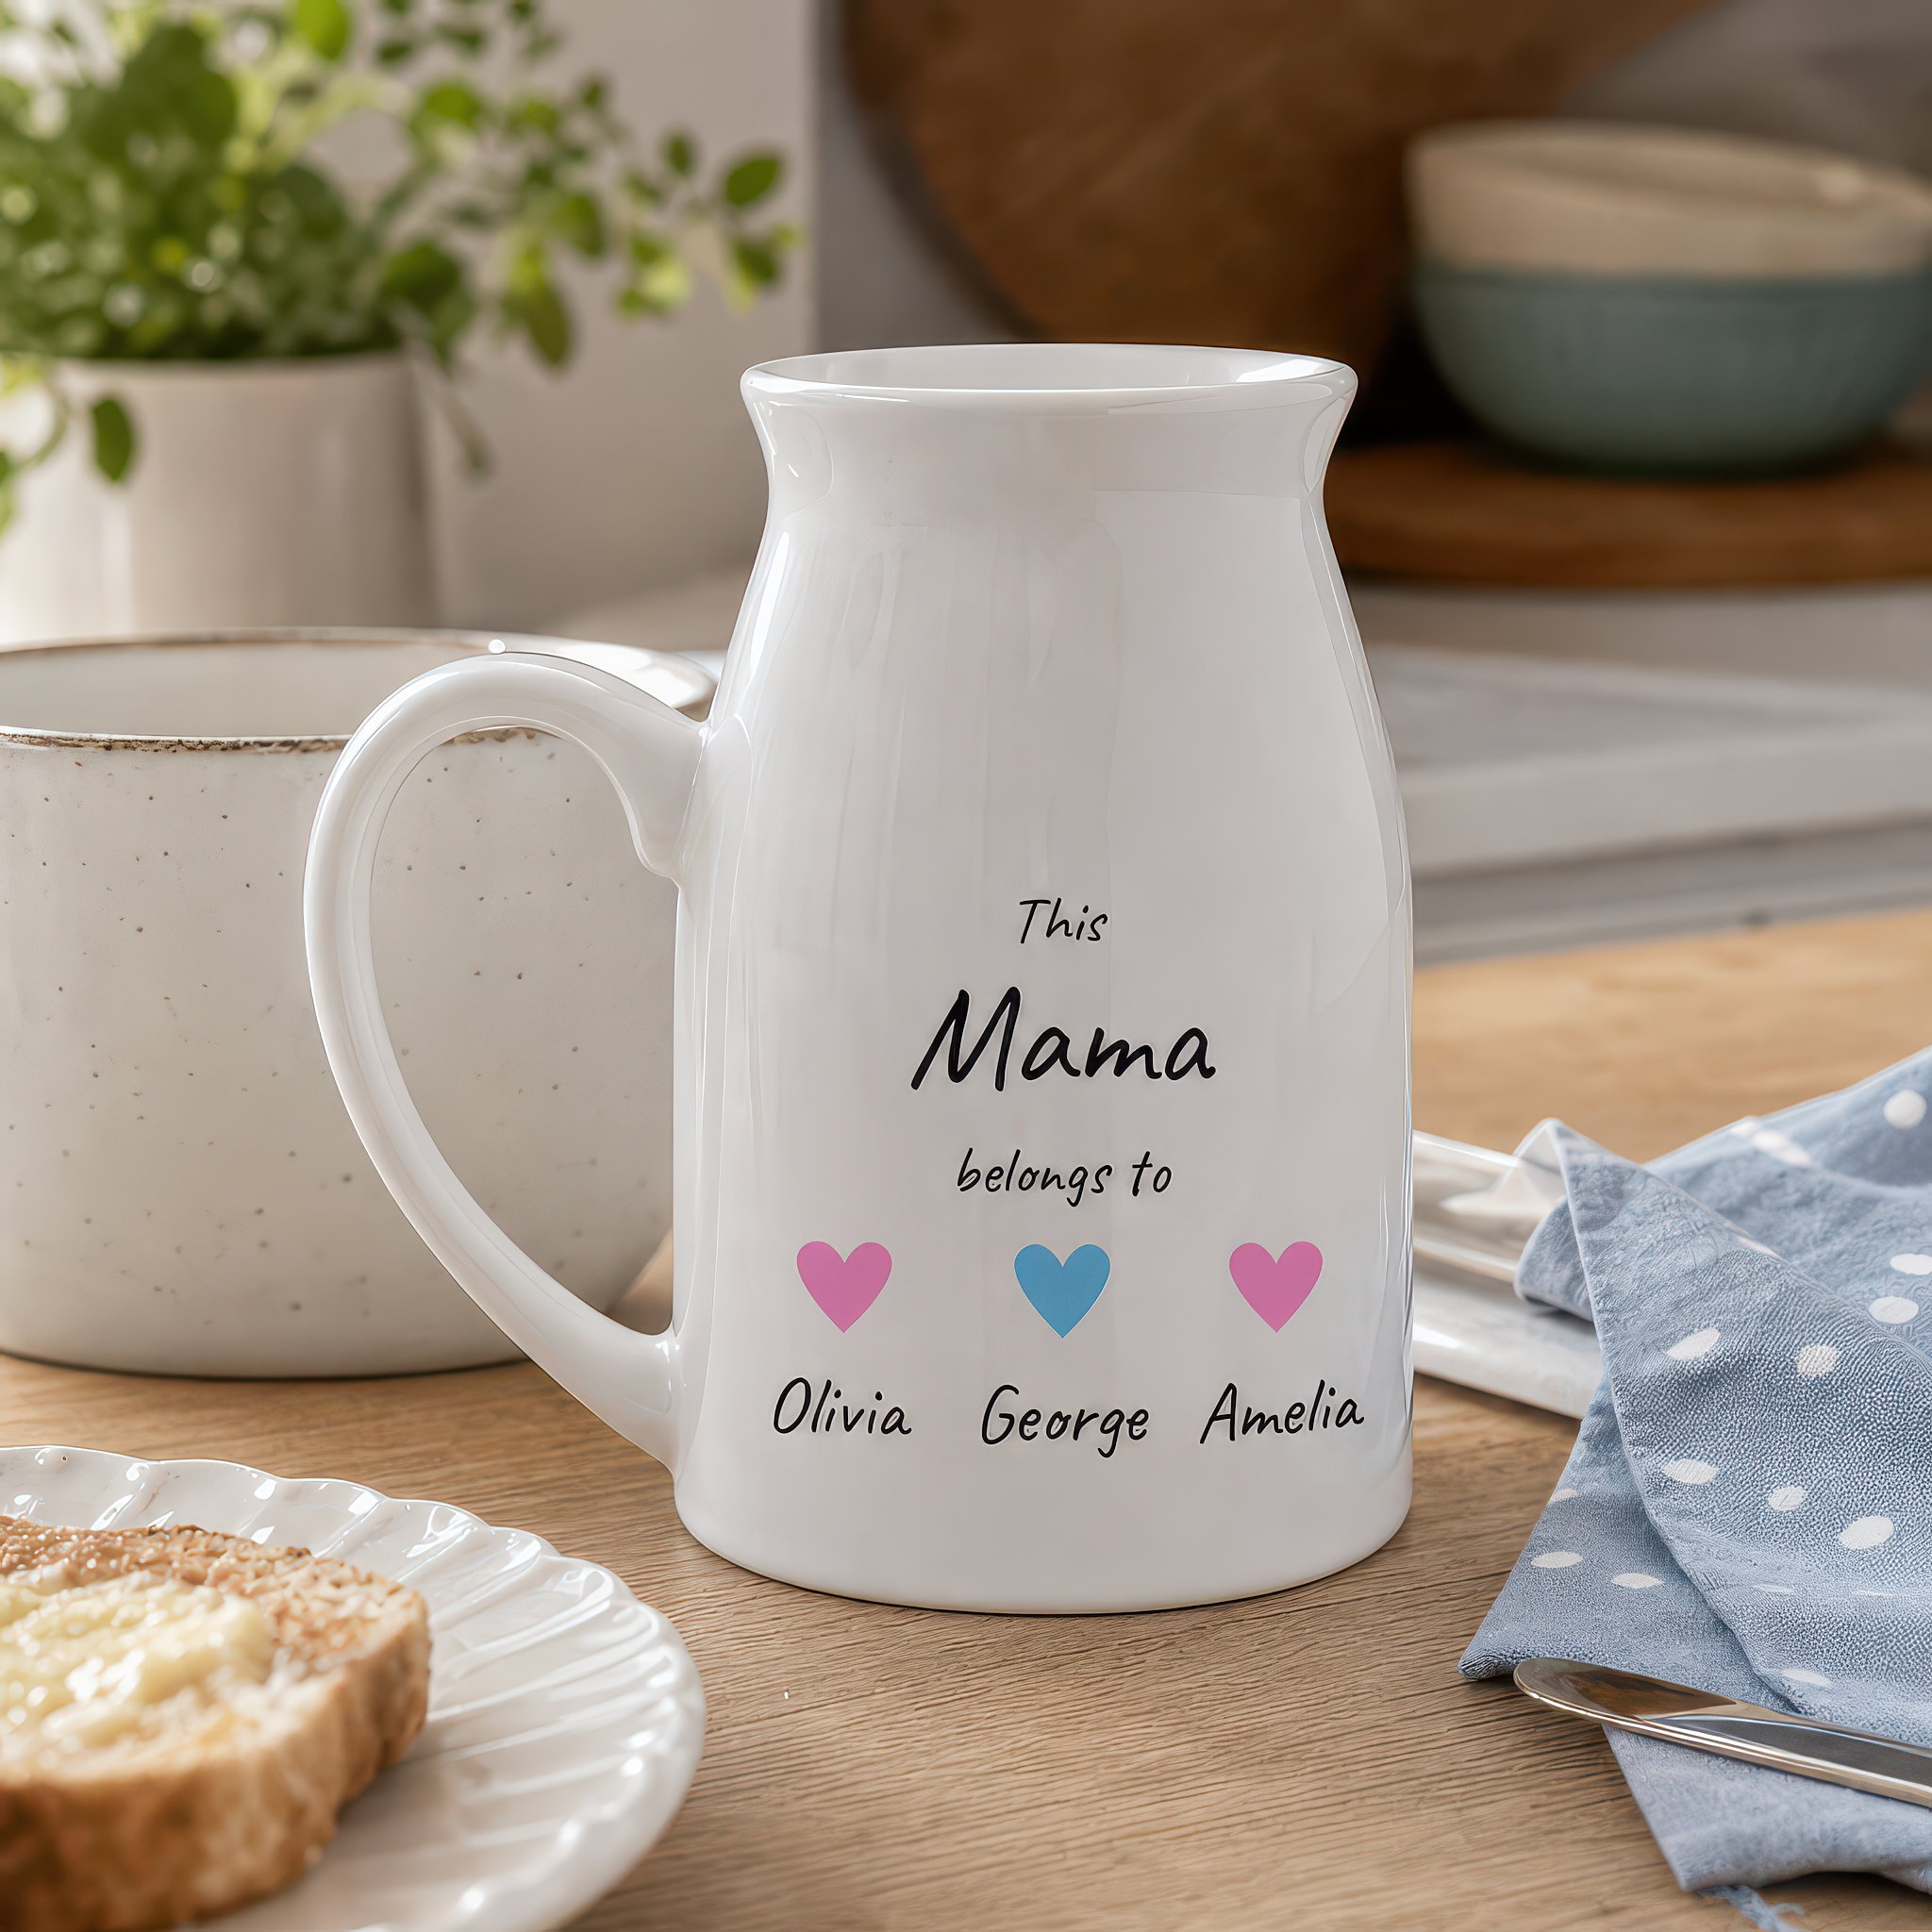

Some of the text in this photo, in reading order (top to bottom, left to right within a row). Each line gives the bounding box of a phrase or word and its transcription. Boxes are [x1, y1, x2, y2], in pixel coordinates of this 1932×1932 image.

[1019, 897, 1108, 944] This
[910, 986, 1217, 1092] Mama
[957, 1147, 1173, 1208] belongs to
[773, 1376, 1365, 1458] Olivia George Amelia
